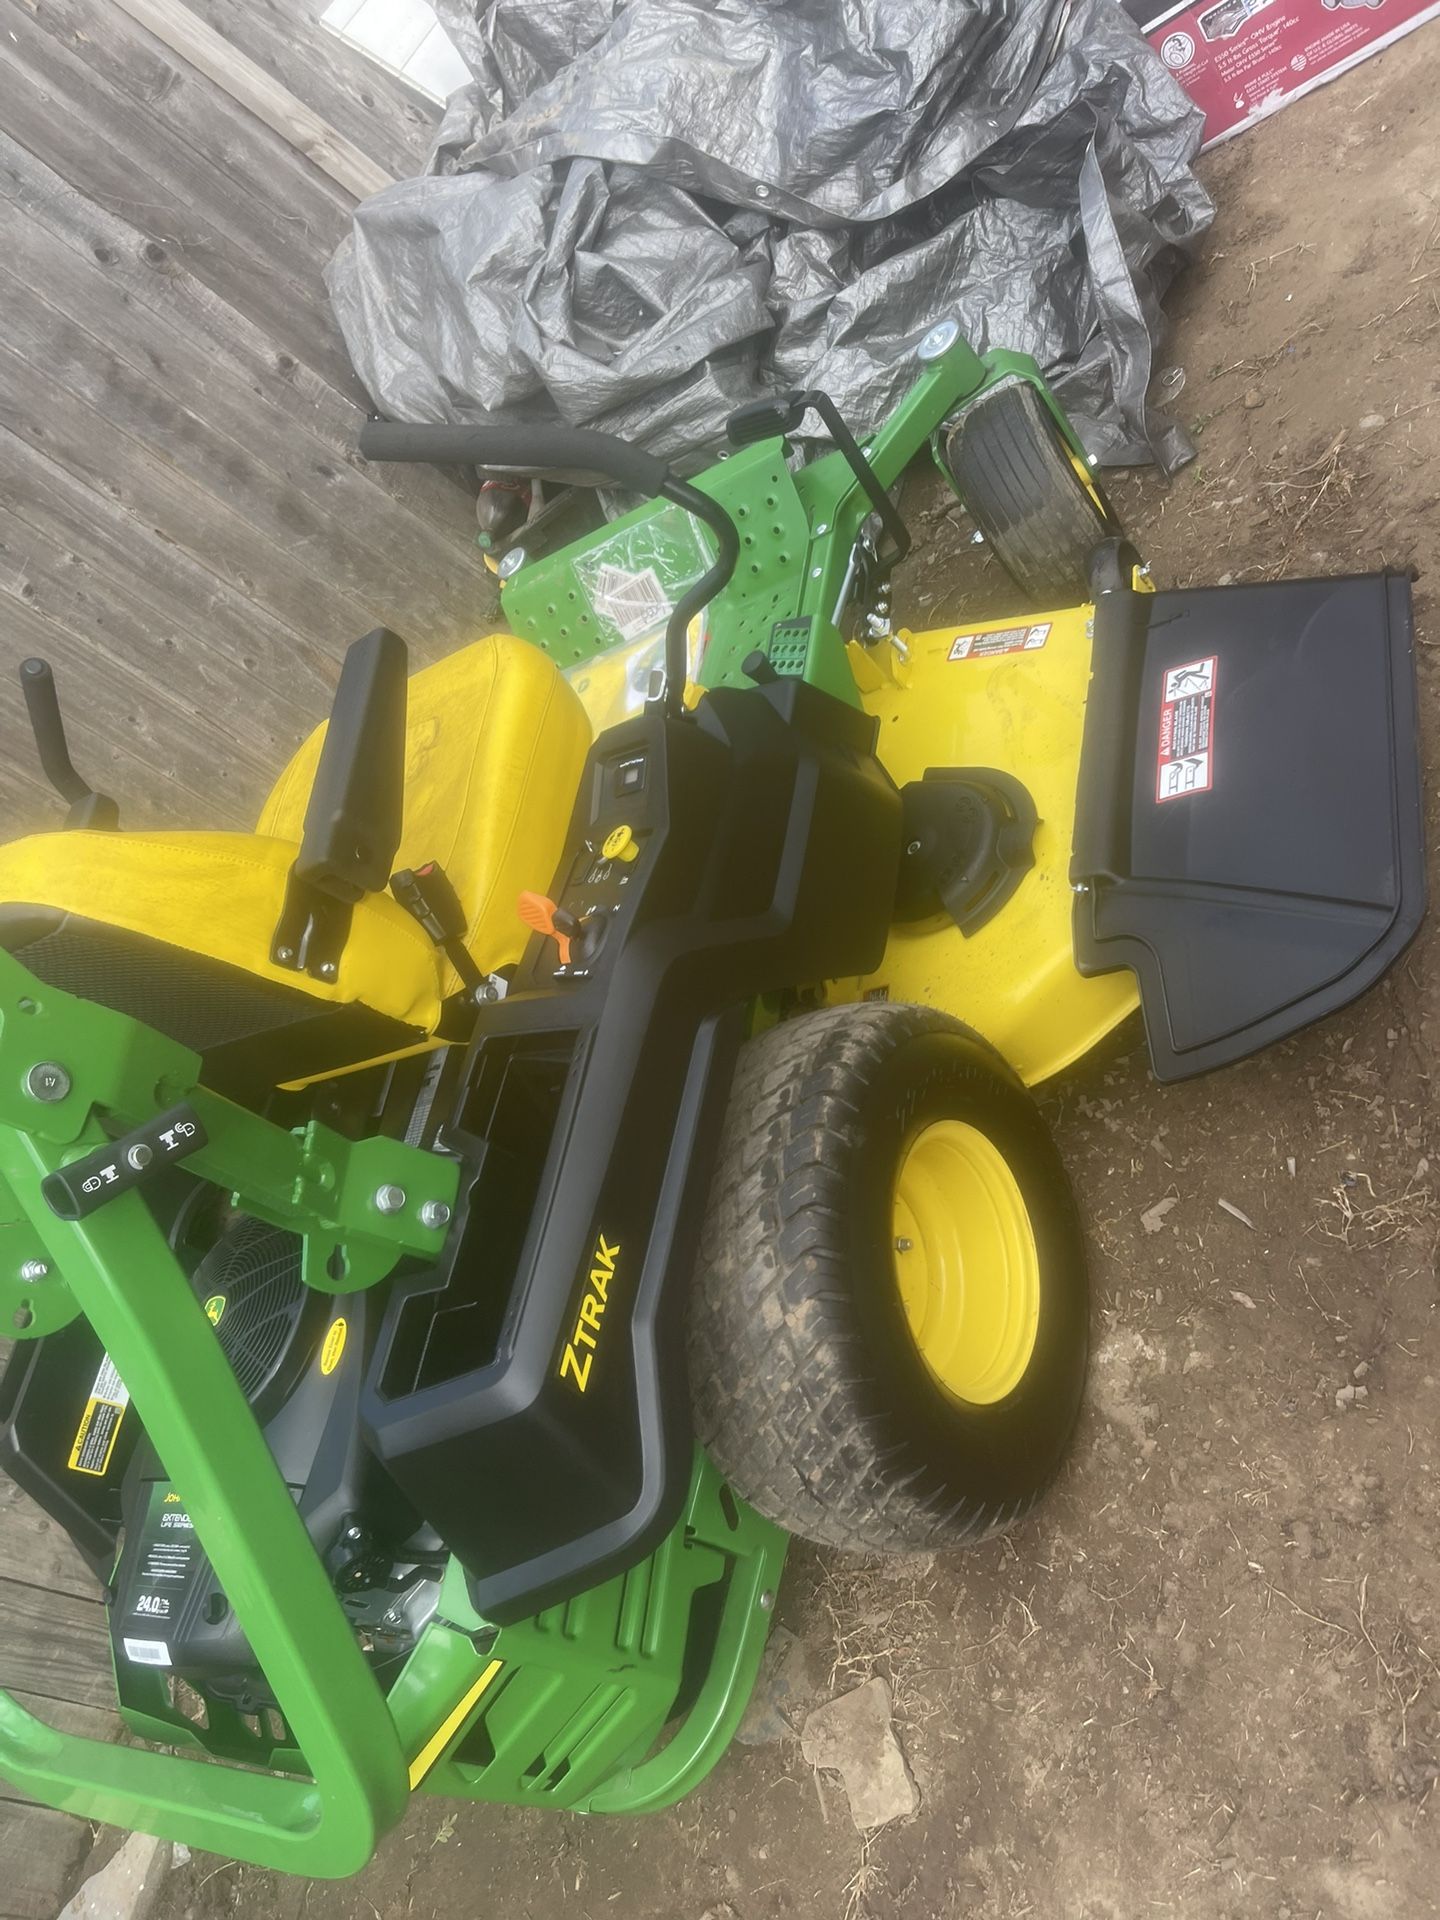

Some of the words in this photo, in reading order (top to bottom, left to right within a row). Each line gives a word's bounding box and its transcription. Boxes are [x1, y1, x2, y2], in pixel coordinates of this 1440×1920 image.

[1266, 15, 1286, 30] Engine
[1163, 709, 1171, 746] DANGER
[560, 1233, 620, 1392] ZTRAK
[78, 1414, 90, 1444] CAUTION
[164, 1492, 180, 1502] JOH
[162, 1513, 192, 1522] EXTEND
[137, 1596, 160, 1612] 24.0
